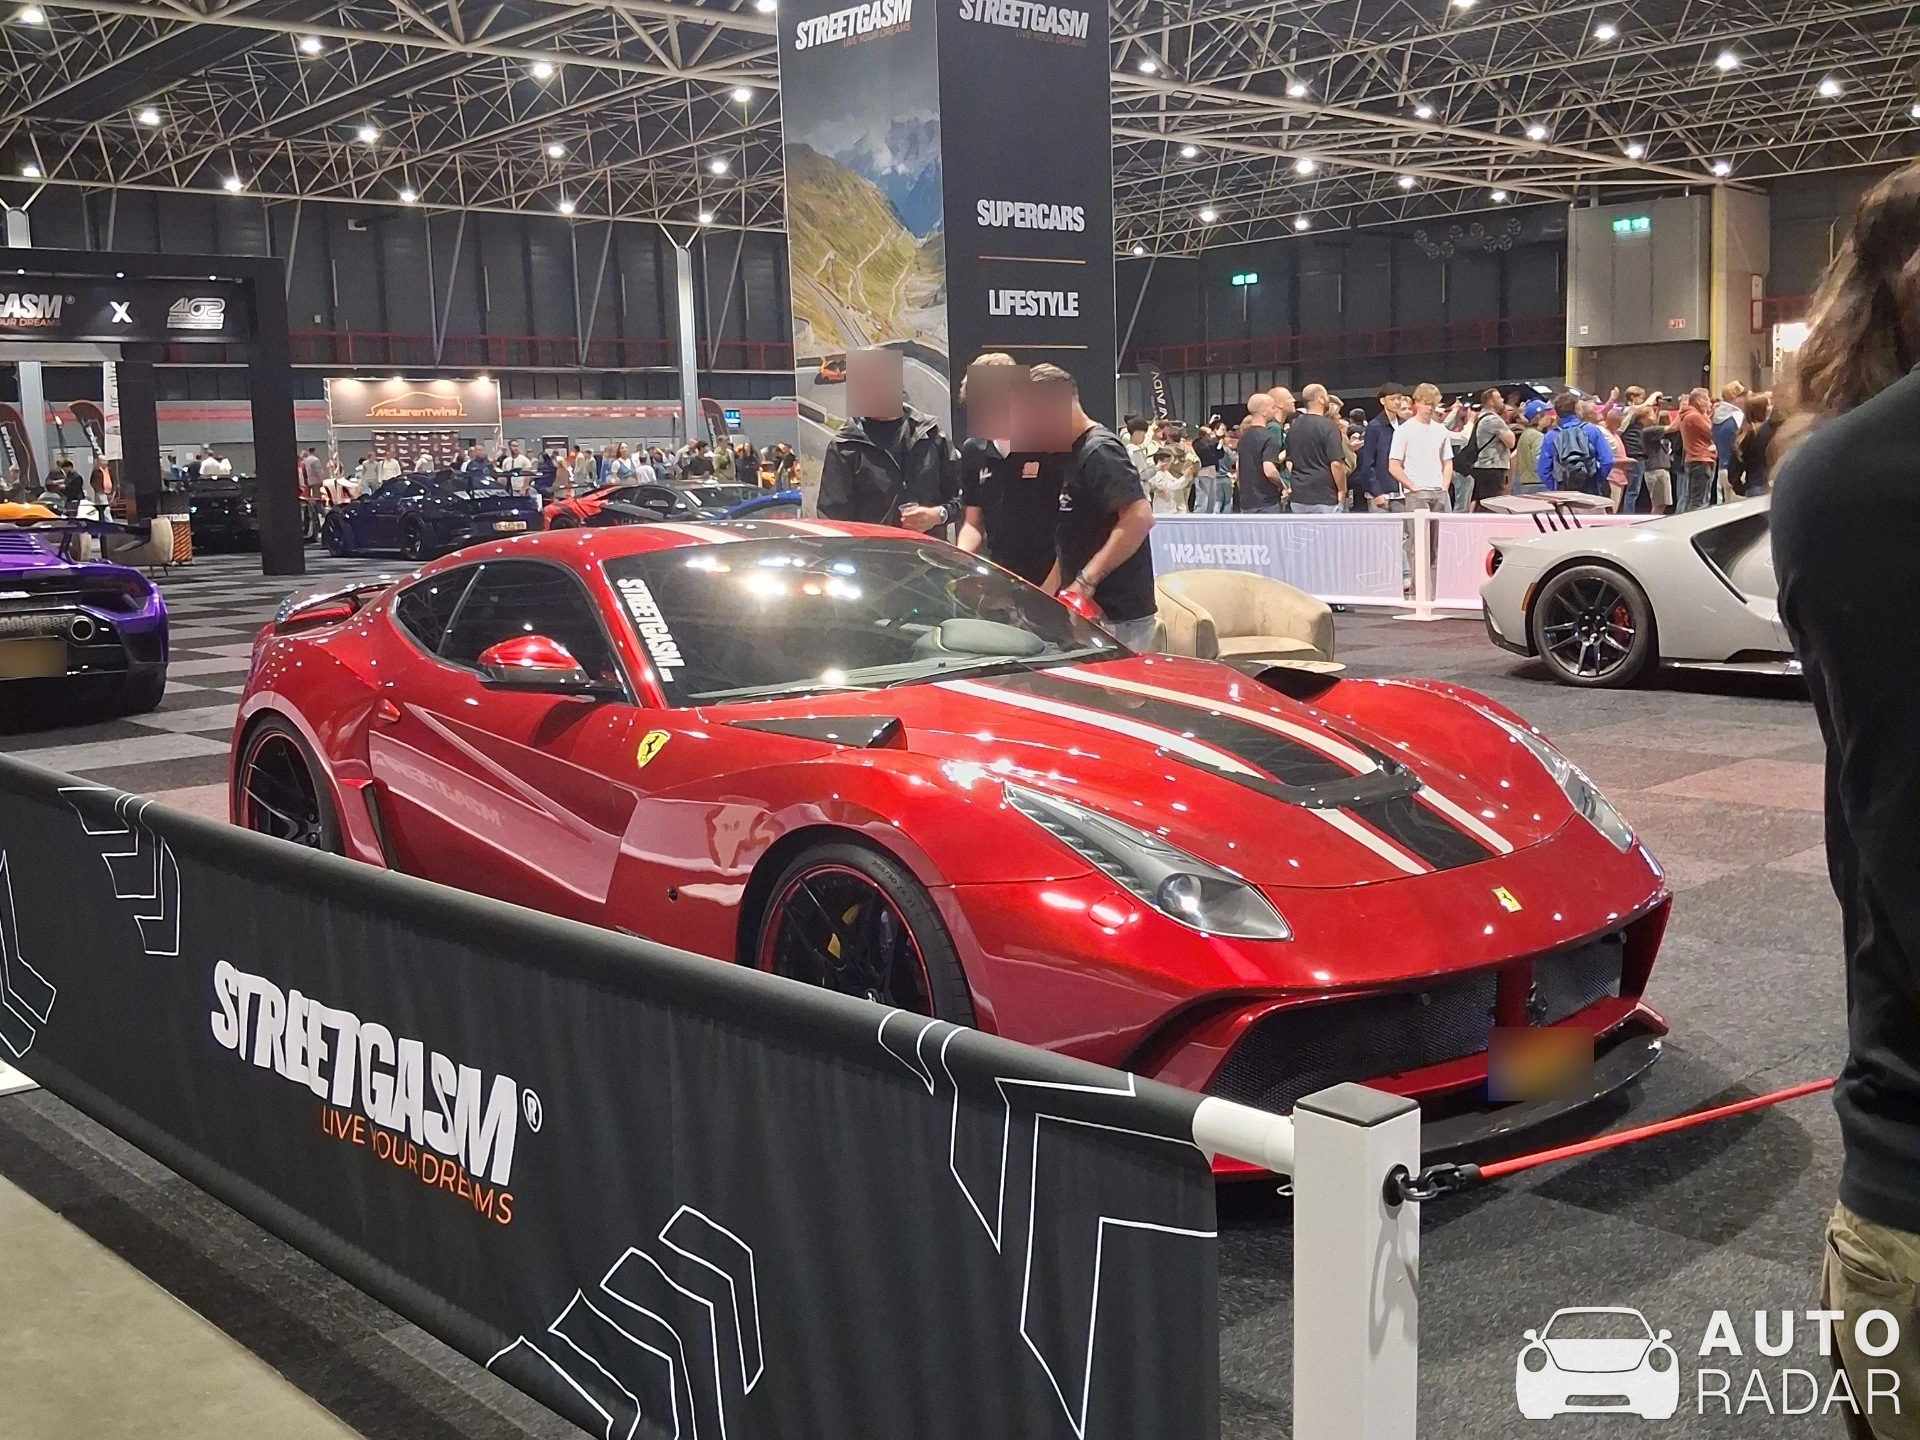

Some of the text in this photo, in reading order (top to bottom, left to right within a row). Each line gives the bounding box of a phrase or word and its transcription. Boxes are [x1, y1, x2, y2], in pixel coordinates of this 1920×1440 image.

[795, 0, 912, 50] STREETGASM
[959, 0, 1089, 39] STREETGASM
[977, 199, 1085, 232] SUPERCARS
[989, 289, 1080, 317] LIFESTYLE
[617, 578, 686, 667] STREETGASM
[321, 1104, 366, 1145] LIVE
[369, 1122, 419, 1175] YOUR
